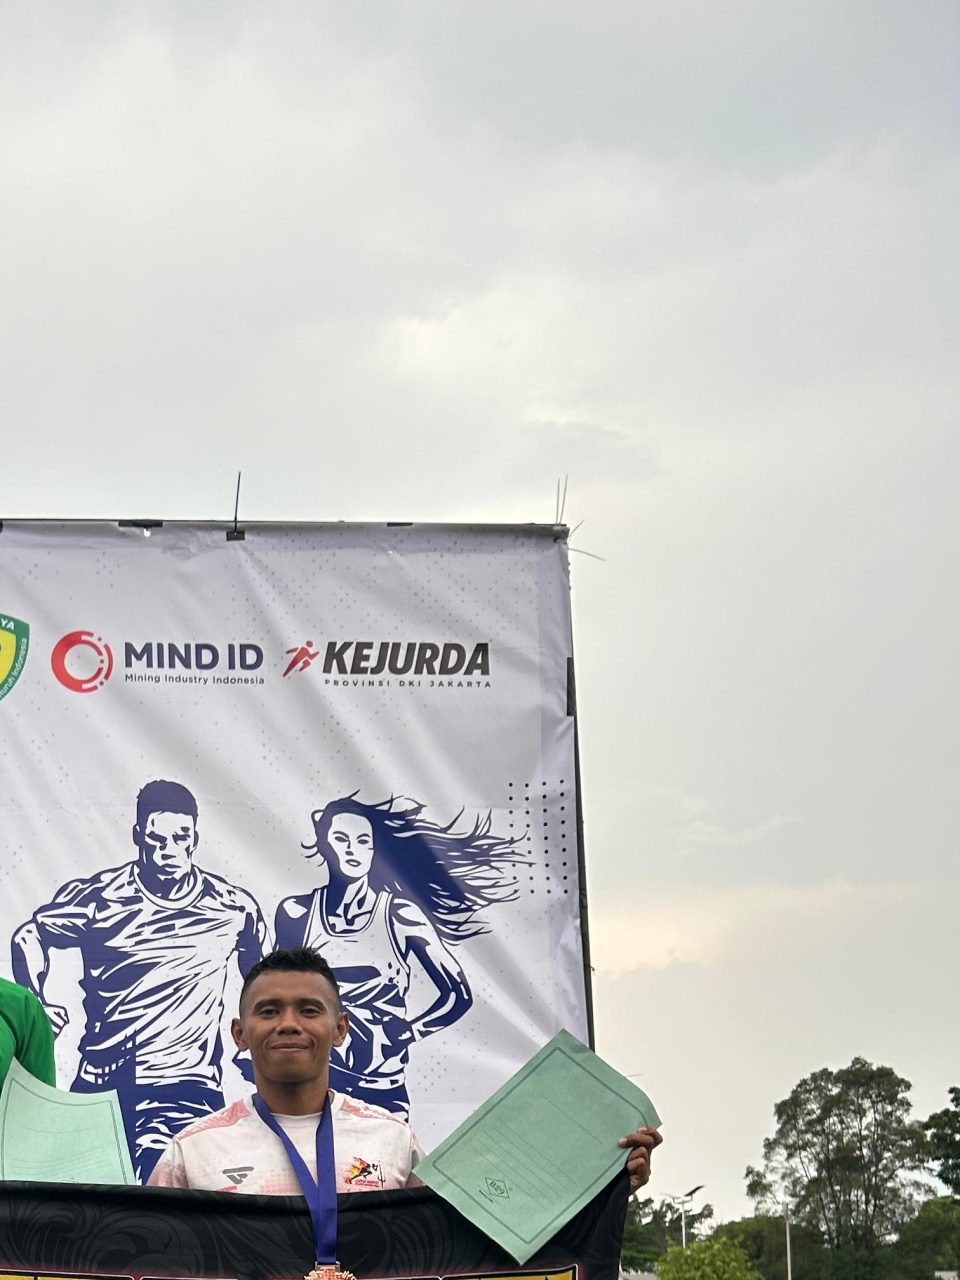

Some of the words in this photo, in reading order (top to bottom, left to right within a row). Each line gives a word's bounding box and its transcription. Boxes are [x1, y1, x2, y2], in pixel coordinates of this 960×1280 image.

[124, 641, 220, 670] MIND
[228, 643, 264, 670] ID
[322, 641, 490, 676] KEJURDA
[125, 674, 160, 684] Mining
[164, 674, 208, 685] Industry
[212, 675, 265, 685] Indonesia
[324, 679, 390, 688] PROVINSI
[399, 680, 421, 688] DKI
[429, 680, 491, 688] JAKARTA
